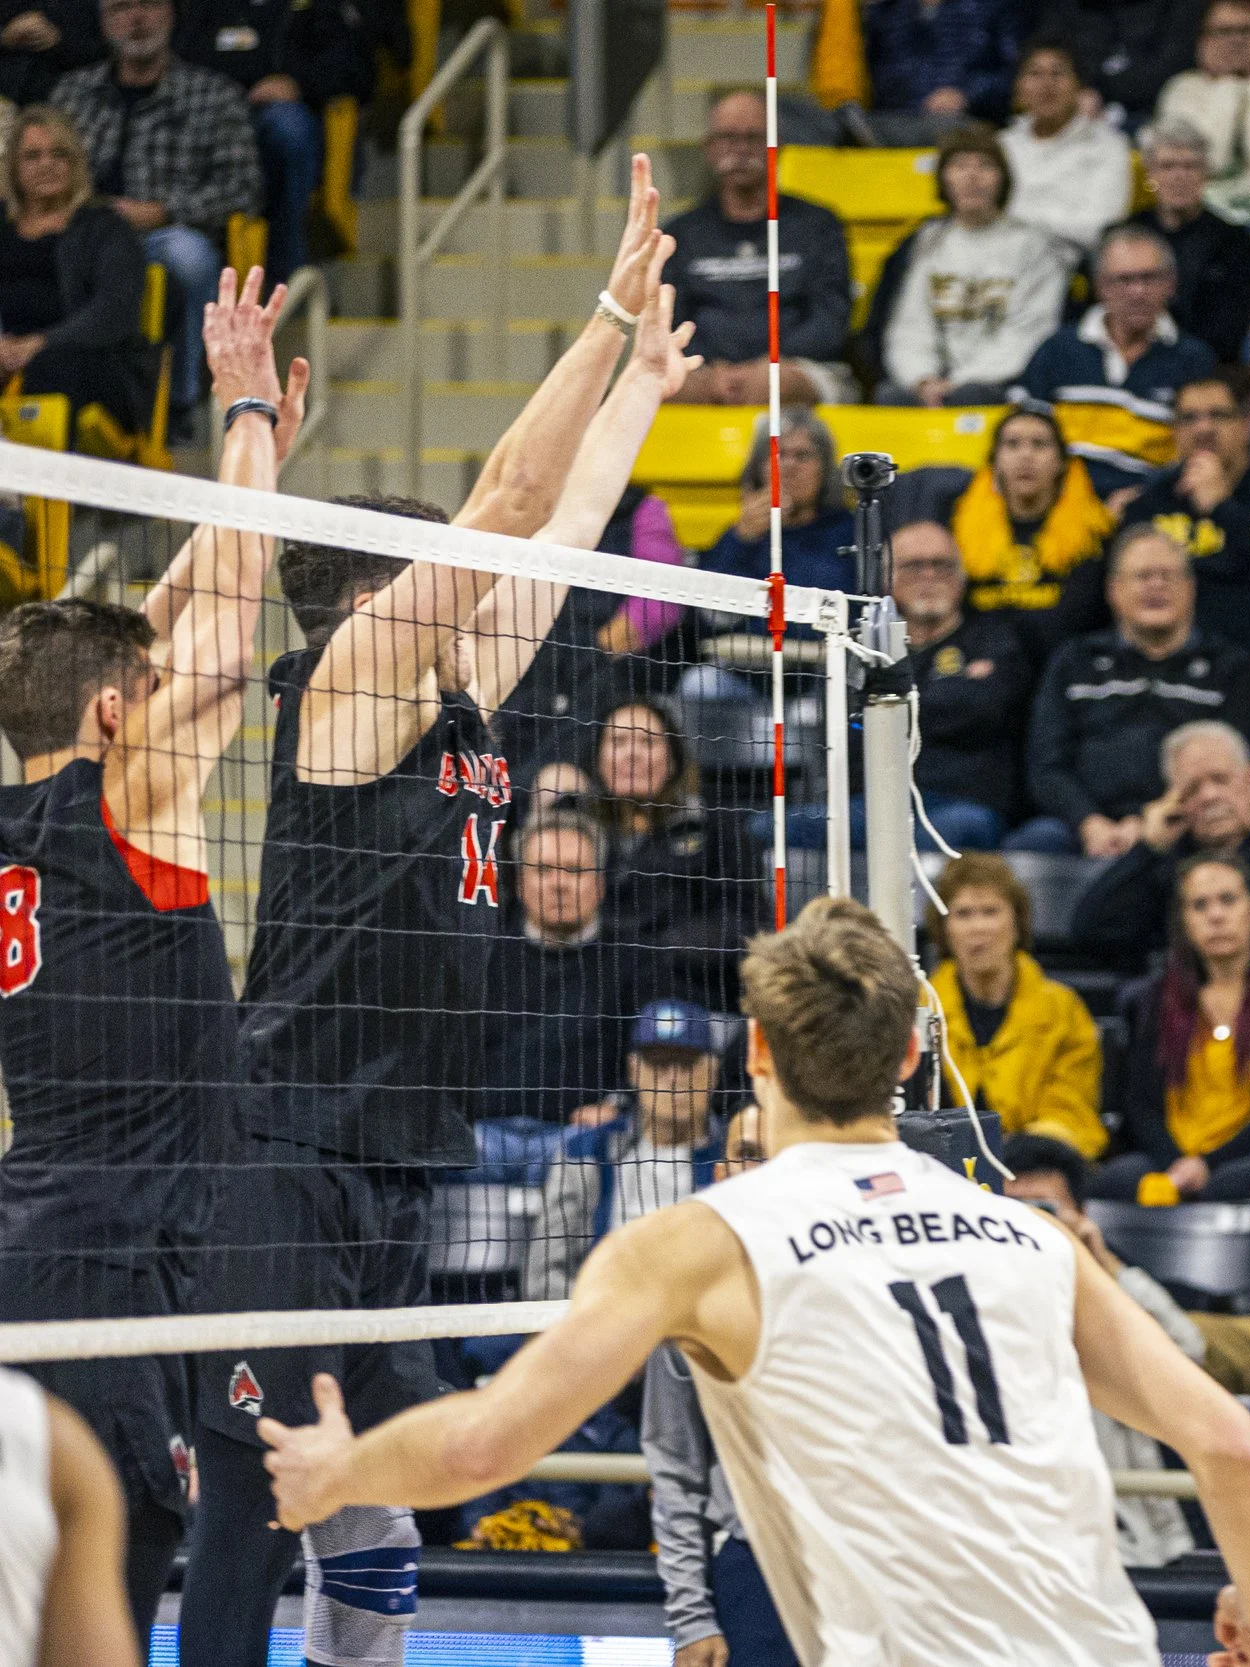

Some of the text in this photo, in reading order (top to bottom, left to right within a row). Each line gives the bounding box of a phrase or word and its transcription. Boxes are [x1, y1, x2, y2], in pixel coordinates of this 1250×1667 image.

[788, 1212, 1042, 1265] LONG BEACH
[886, 1272, 1012, 1445] 11
